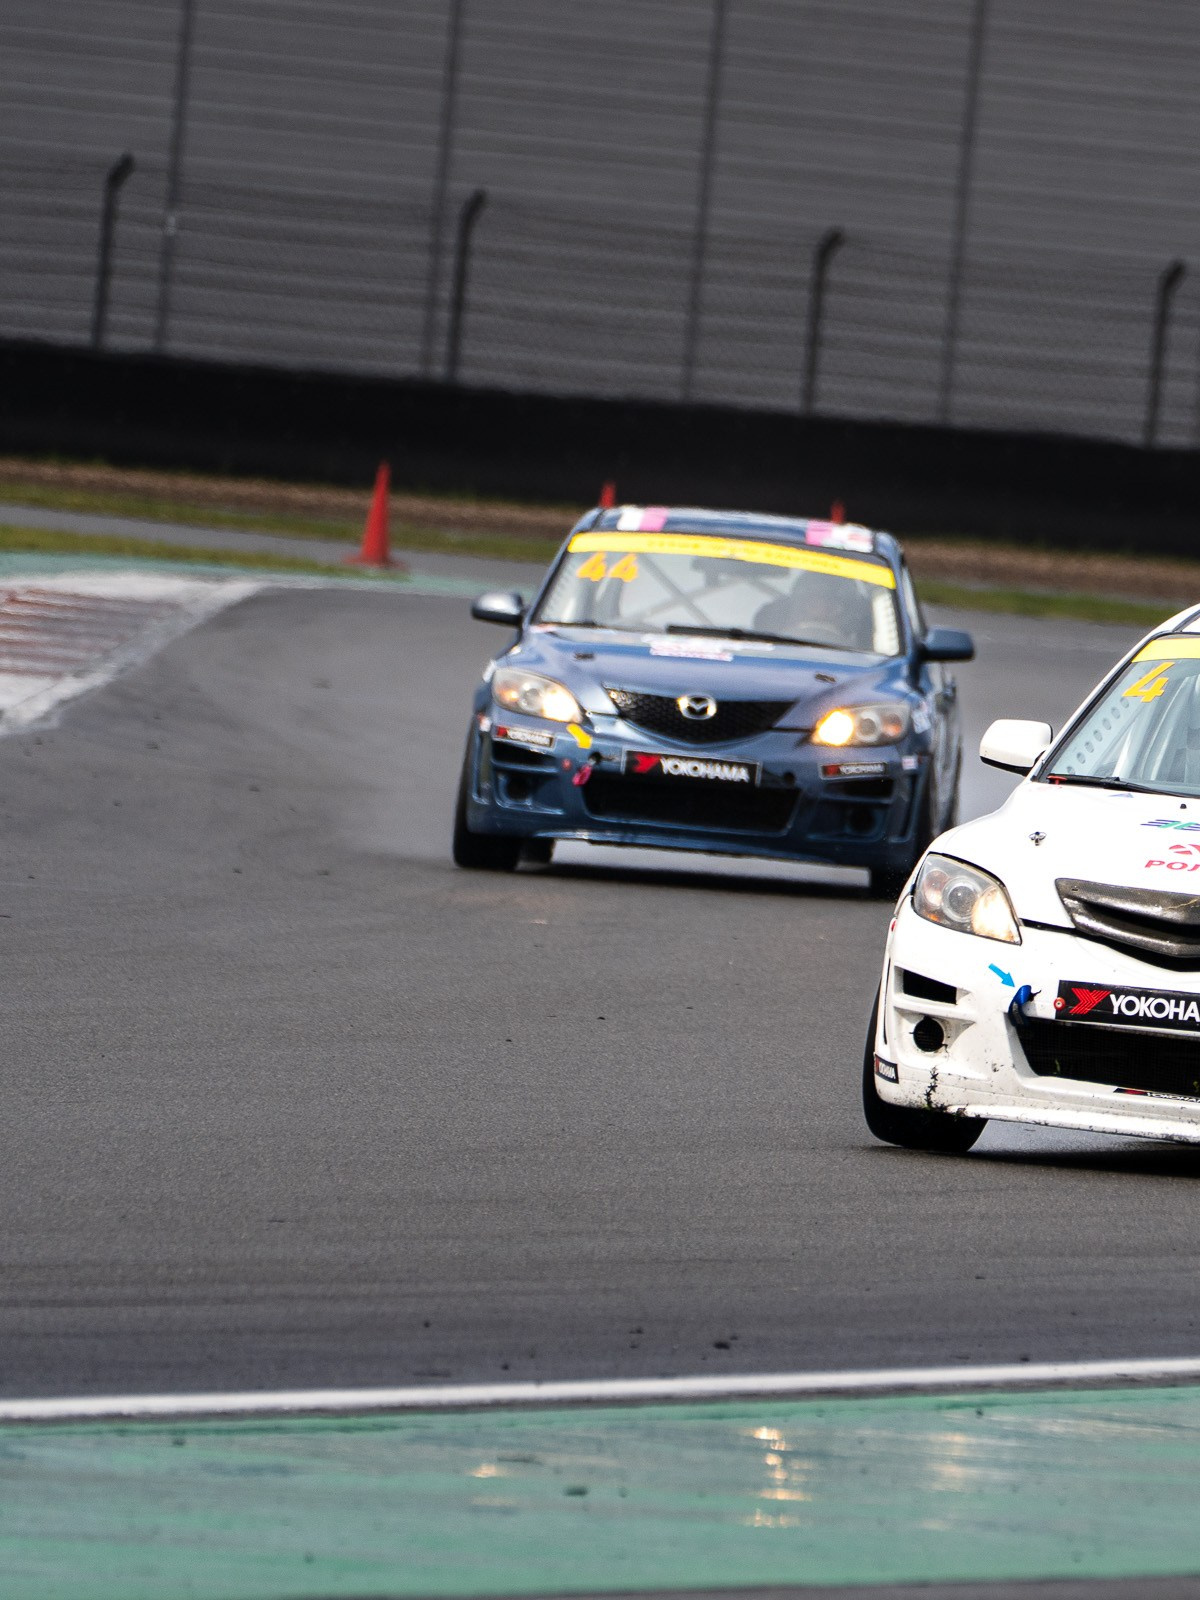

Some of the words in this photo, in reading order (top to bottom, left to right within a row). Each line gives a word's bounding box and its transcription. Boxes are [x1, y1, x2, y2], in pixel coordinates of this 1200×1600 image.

[576, 552, 639, 582] 44
[1122, 661, 1176, 703] 4
[659, 756, 750, 784] YOKOHAMA
